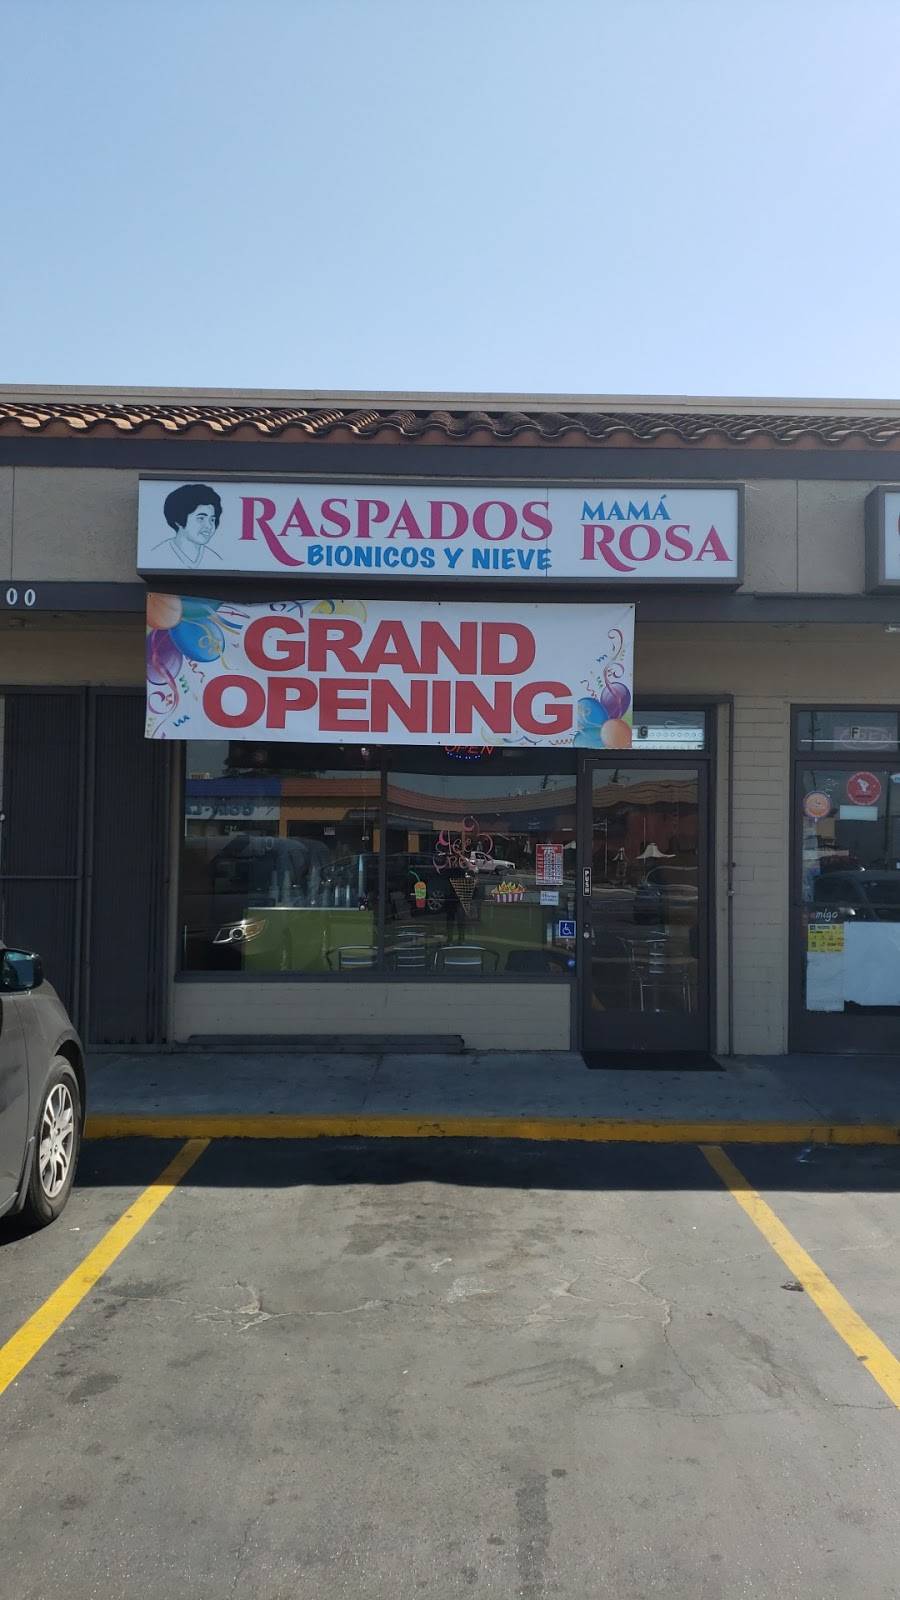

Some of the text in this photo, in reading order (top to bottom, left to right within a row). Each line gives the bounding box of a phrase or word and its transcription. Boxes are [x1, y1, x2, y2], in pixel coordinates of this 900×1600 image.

[580, 494, 671, 521] MAMÁ
[238, 496, 553, 566] RASPADOS
[579, 524, 733, 572] ROSA
[306, 544, 553, 571] BIONICOS Y NIEVE
[243, 615, 537, 676] GRAND
[202, 674, 574, 736] OPENING
[639, 725, 648, 737] G
[851, 727, 860, 739] F
